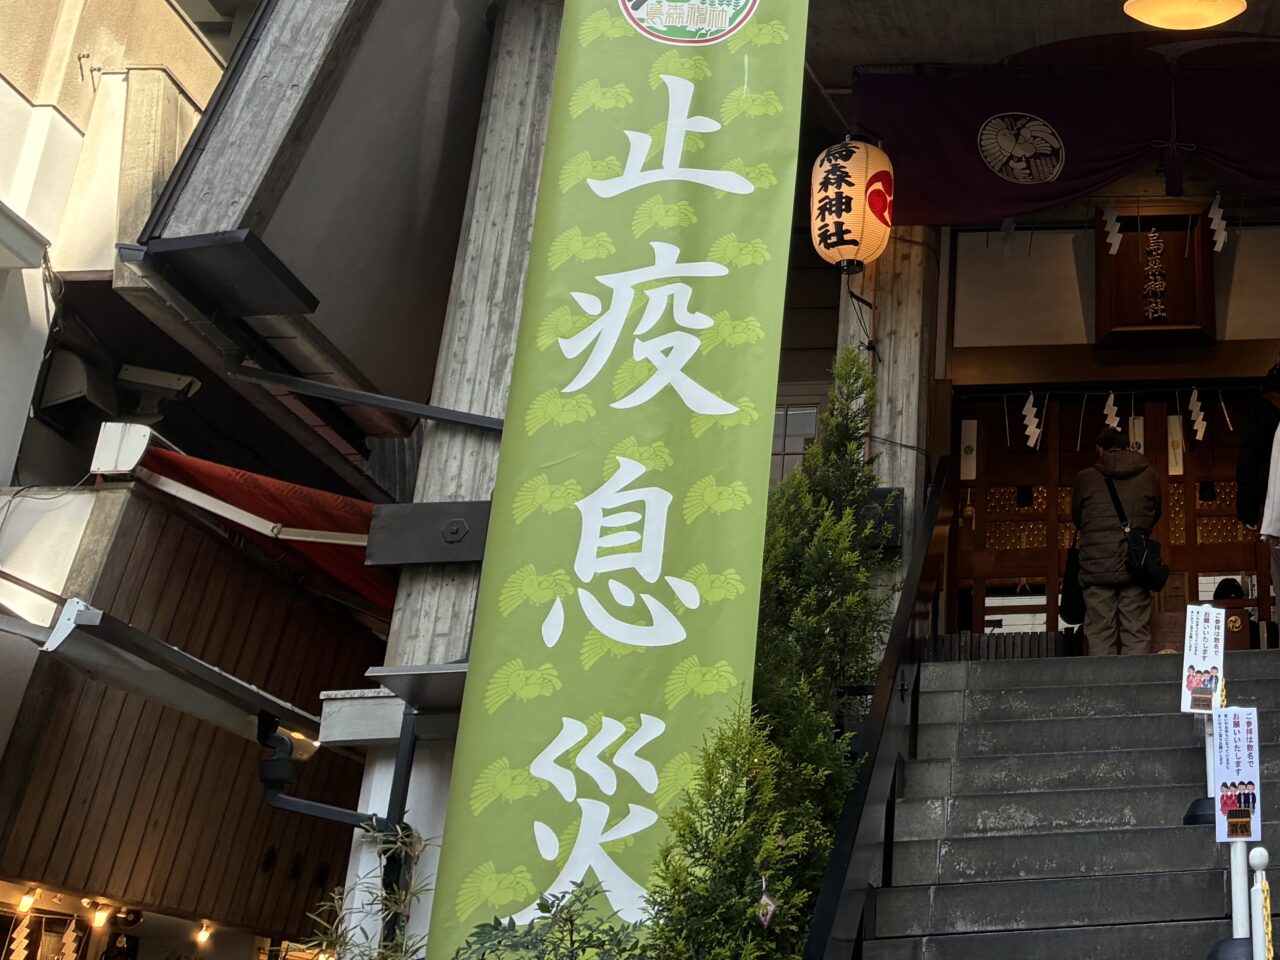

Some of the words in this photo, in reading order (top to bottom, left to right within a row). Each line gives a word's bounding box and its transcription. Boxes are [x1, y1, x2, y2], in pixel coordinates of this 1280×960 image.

[815, 141, 860, 251] 烏森神社
[1143, 227, 1167, 320] 烏森神社
[501, 75, 754, 926] 止疫息災
